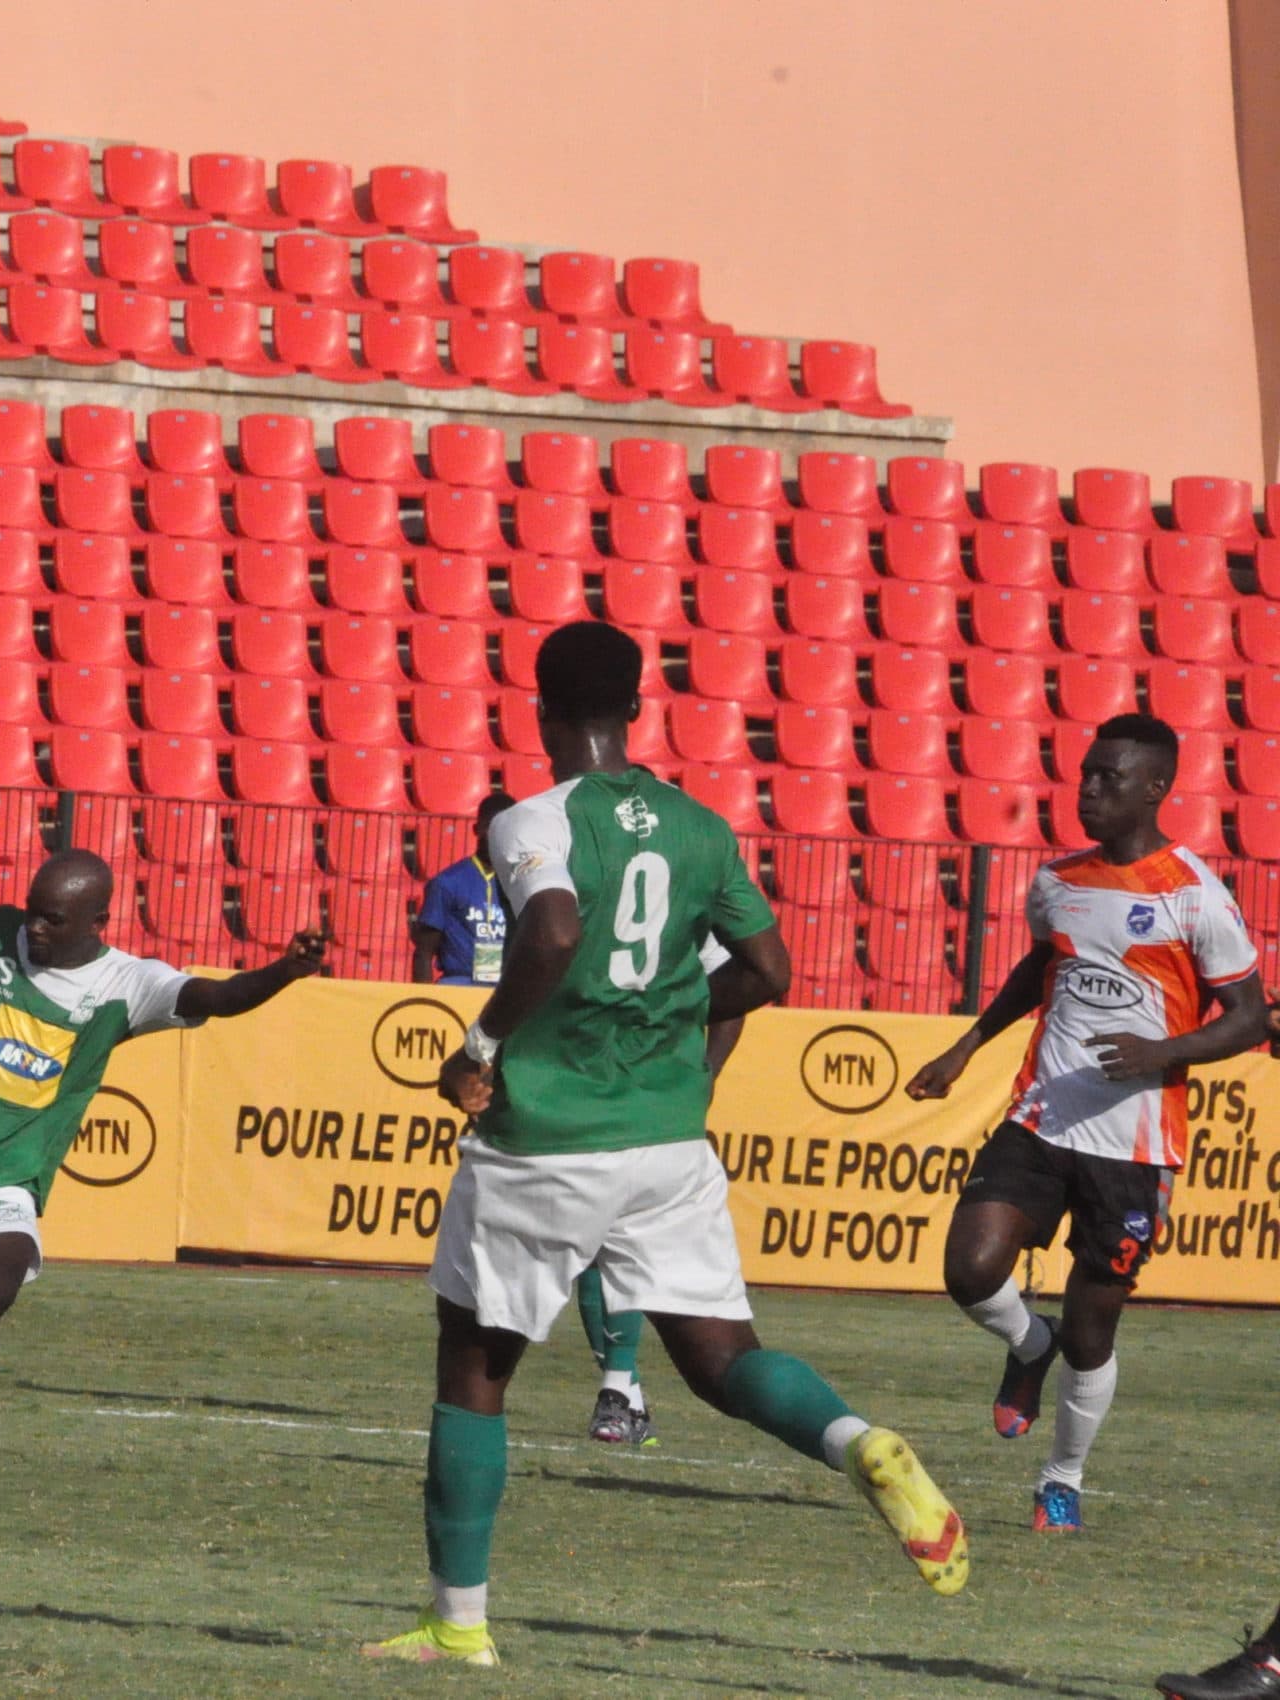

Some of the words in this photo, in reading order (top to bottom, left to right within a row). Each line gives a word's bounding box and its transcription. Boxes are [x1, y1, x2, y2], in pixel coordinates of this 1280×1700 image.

[609, 851, 670, 991] 9
[1079, 976, 1123, 997] MTN
[395, 1027, 446, 1060] MTN
[824, 1053, 875, 1087] MTN
[73, 1118, 130, 1155] MTN
[235, 1105, 344, 1160] POUR
[351, 1113, 399, 1162] LE
[782, 1137, 829, 1187] LE
[1187, 1127, 1261, 1191] fait
[328, 1184, 384, 1235] DU
[760, 1208, 817, 1258] DU
[823, 1211, 930, 1264] FOOT
[1111, 1238, 1140, 1275] 3
